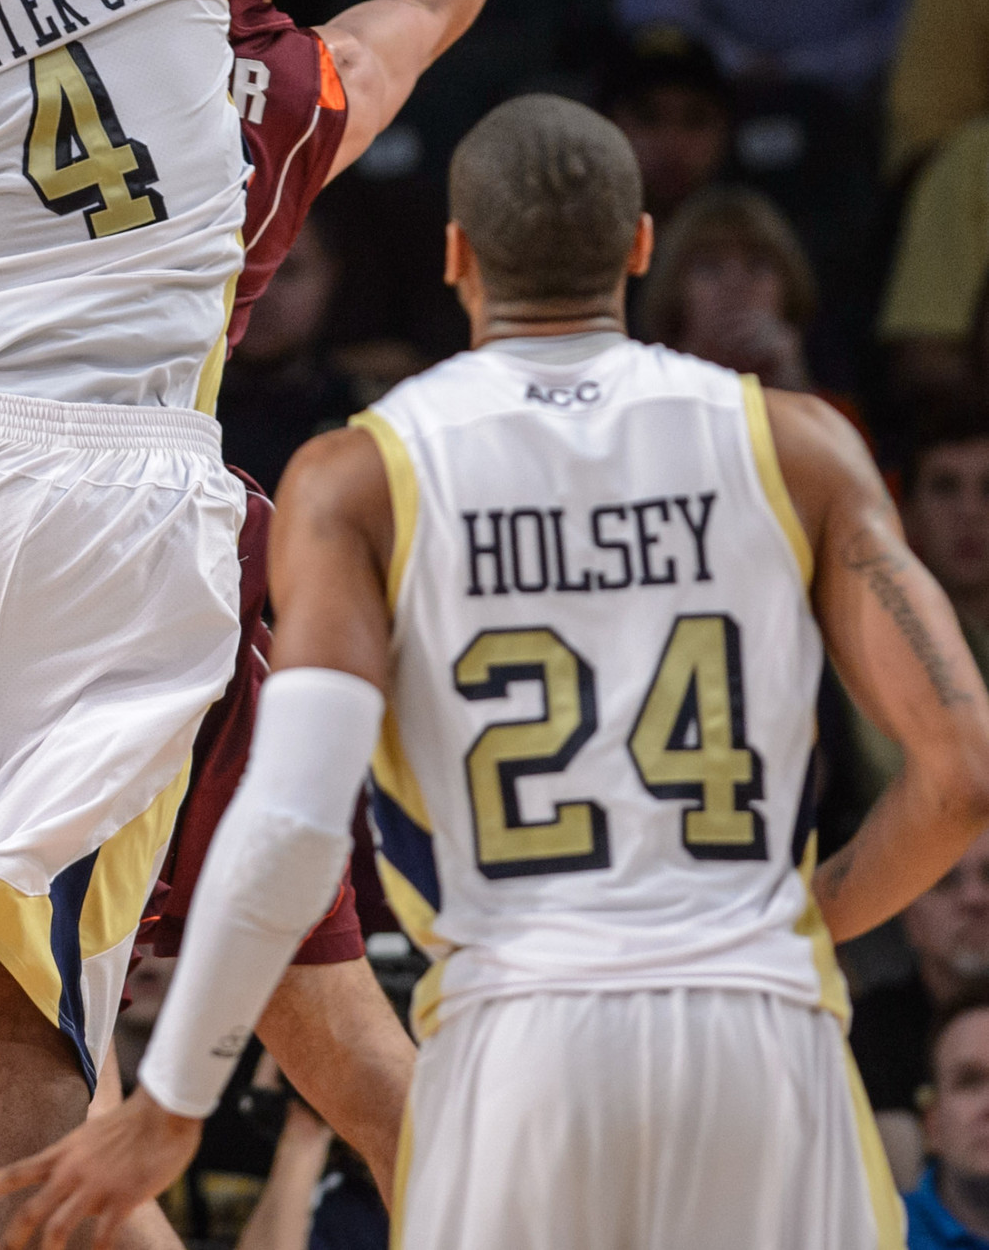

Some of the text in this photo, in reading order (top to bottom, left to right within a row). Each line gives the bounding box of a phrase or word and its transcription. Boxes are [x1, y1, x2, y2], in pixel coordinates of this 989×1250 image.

[22, 39, 169, 240] 4
[232, 57, 271, 125] R
[525, 379, 601, 408] ACC
[462, 491, 717, 597] HOLSEY
[452, 612, 770, 881] 24
